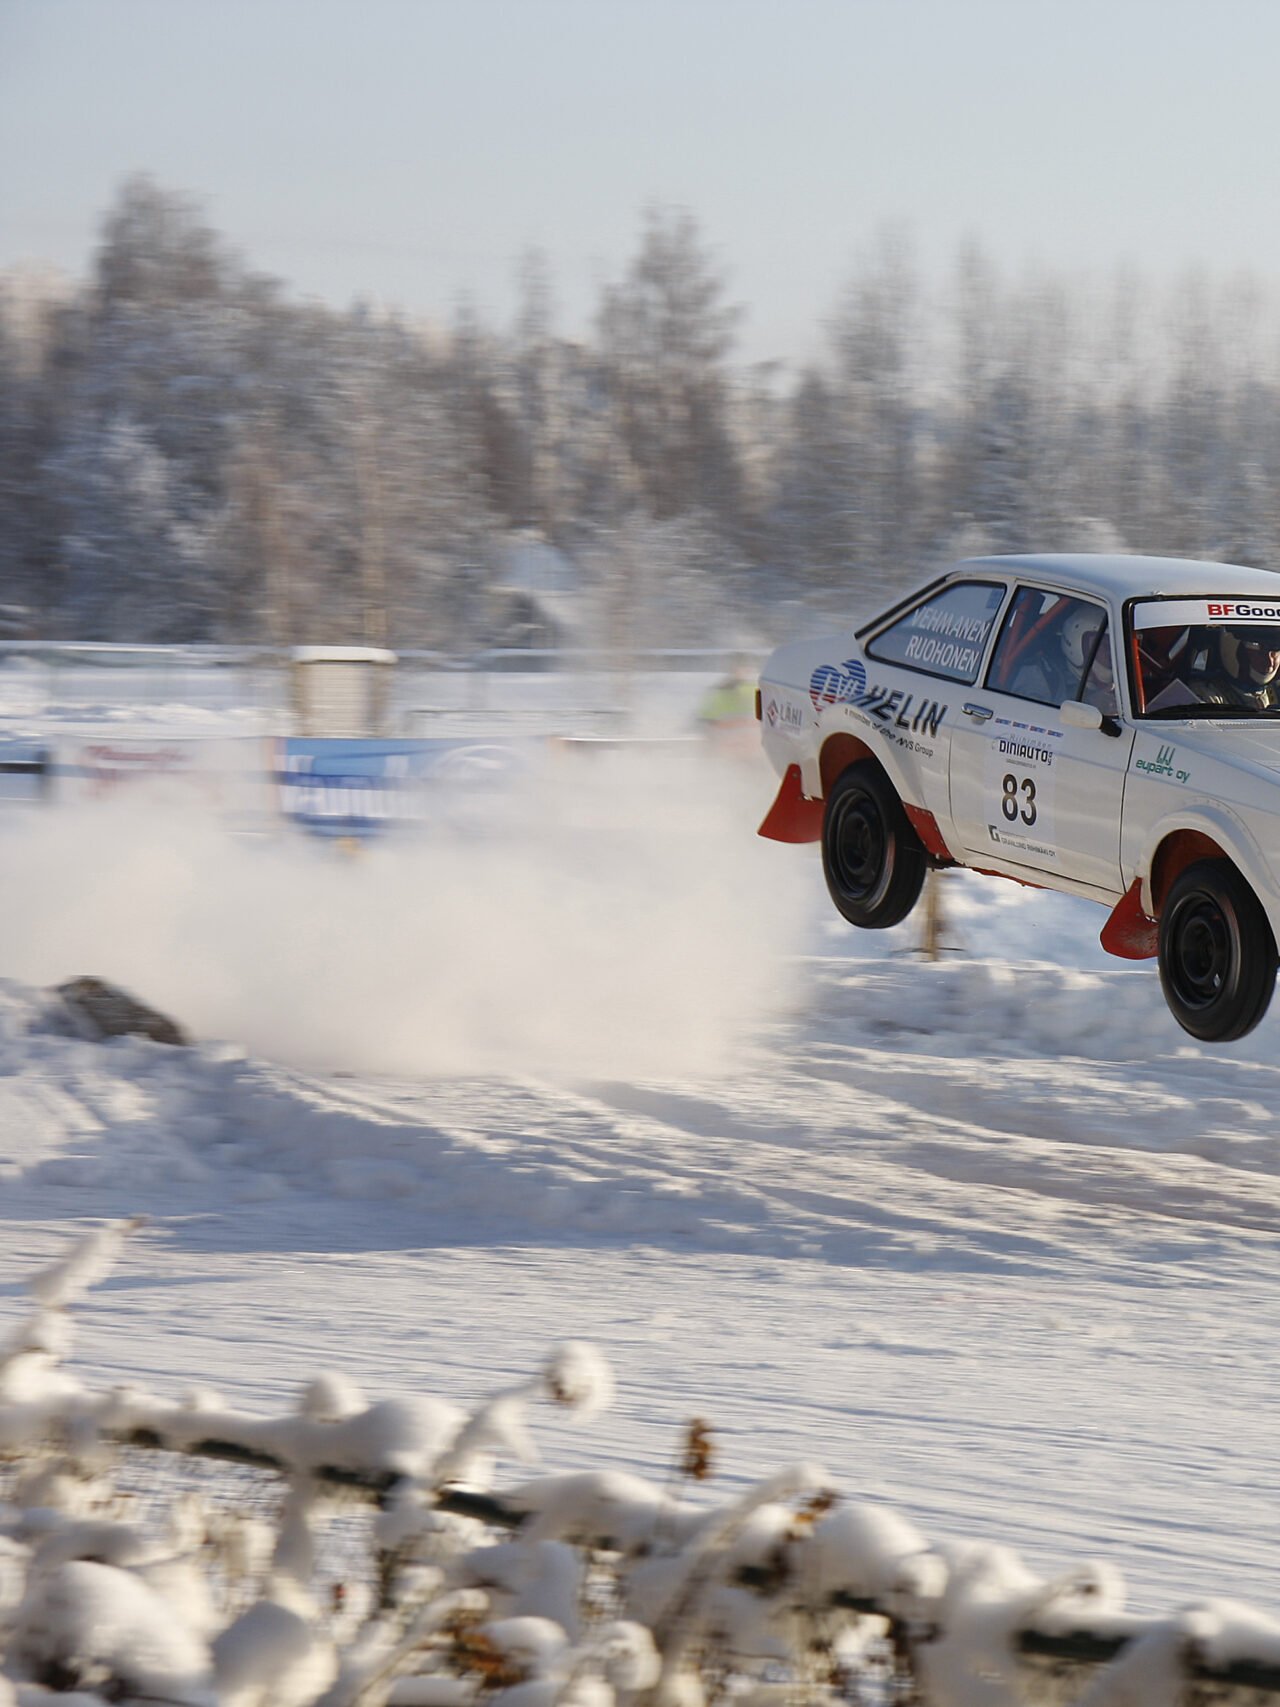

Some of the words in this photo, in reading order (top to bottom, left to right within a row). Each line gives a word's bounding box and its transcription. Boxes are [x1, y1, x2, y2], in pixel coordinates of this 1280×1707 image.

[911, 606, 991, 643] VEHMANEN
[905, 635, 979, 672] RUOHONEN
[999, 740, 1049, 763] DINIAUTO
[1136, 760, 1174, 776] eupart
[1002, 773, 1038, 826] 83
